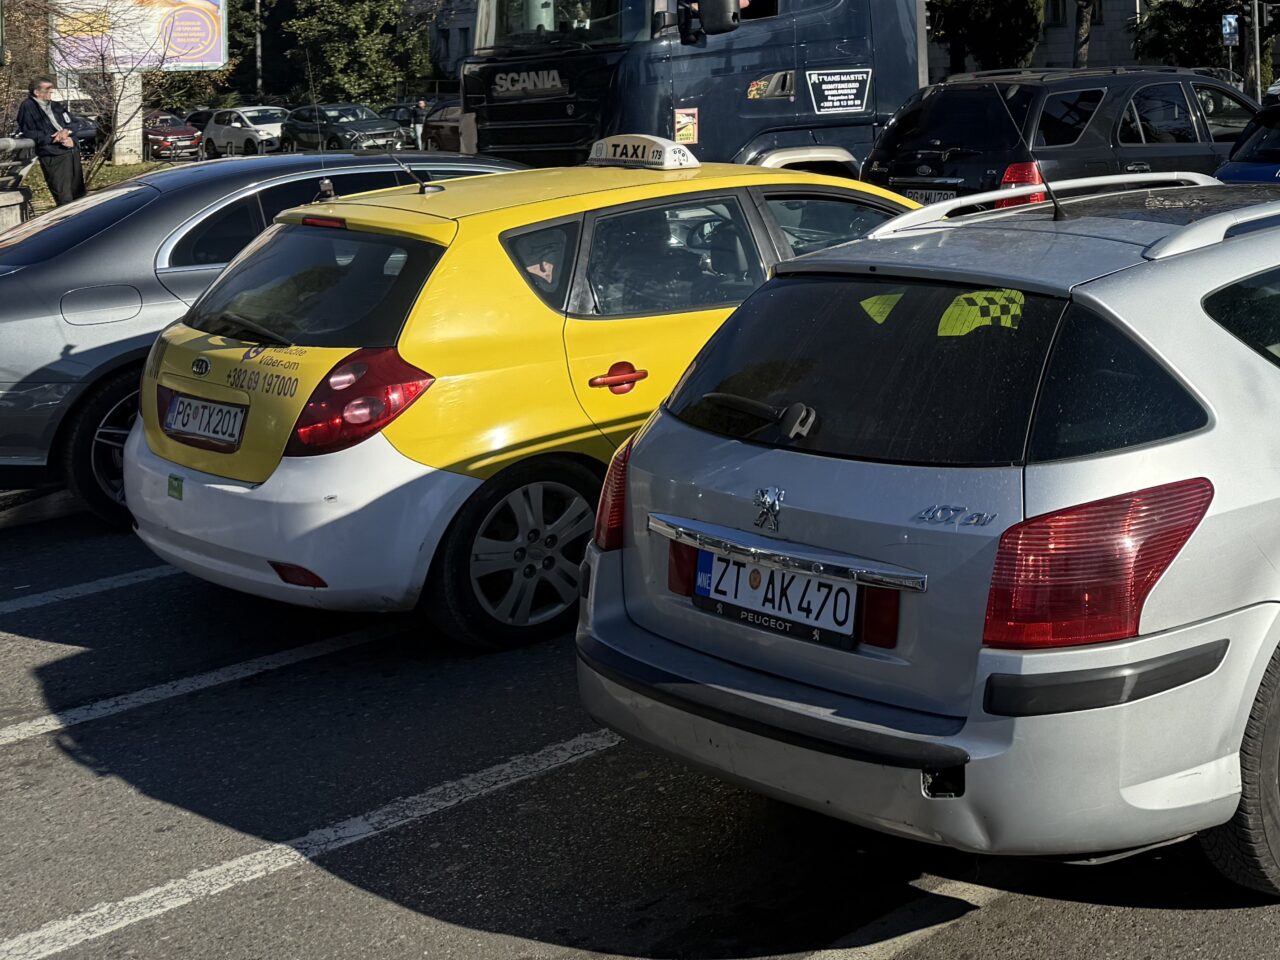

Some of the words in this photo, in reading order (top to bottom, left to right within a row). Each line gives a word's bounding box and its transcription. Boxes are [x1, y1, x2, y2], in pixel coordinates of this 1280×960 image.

[495, 70, 562, 91] SCANIA
[612, 144, 647, 159] TAXI
[651, 150, 663, 159] 179
[259, 356, 300, 370] Viber-om
[227, 368, 247, 388] +382
[247, 371, 260, 391] 69
[261, 373, 299, 398] 197000
[174, 401, 192, 427] PG
[198, 405, 239, 438] TX201
[697, 572, 711, 590] MNE
[714, 557, 746, 600] ZT
[761, 570, 850, 627] AK470
[740, 611, 792, 632] PEUGEOT
